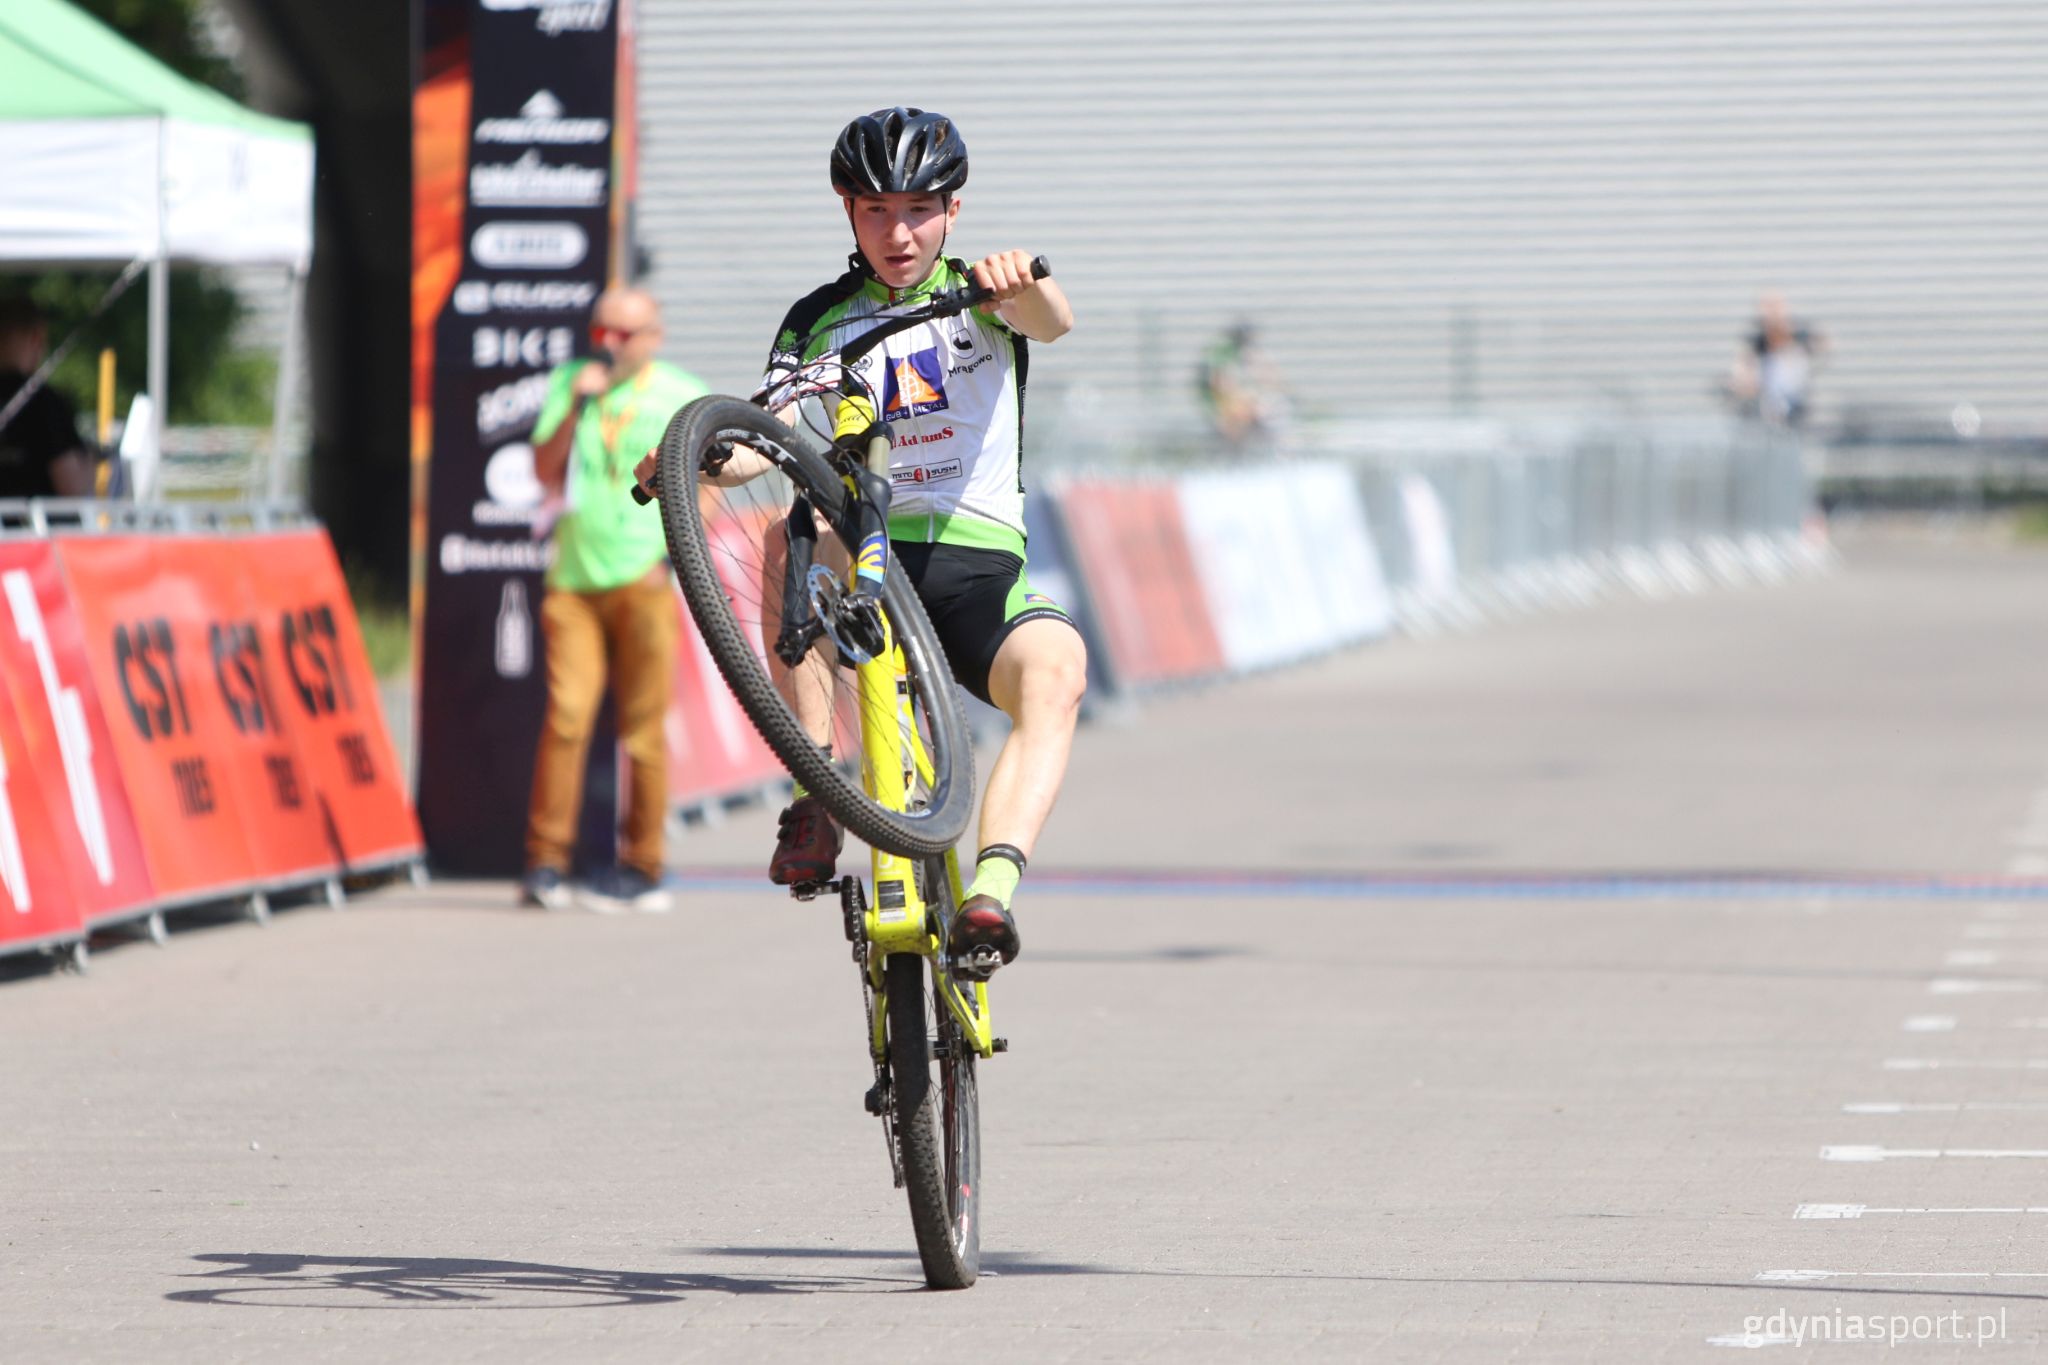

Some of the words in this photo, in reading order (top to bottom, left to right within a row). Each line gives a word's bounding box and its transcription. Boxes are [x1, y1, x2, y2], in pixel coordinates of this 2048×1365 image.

[913, 402, 945, 414] METAL
[113, 614, 192, 742] CST
[208, 617, 282, 735] CST
[281, 602, 356, 720] CST
